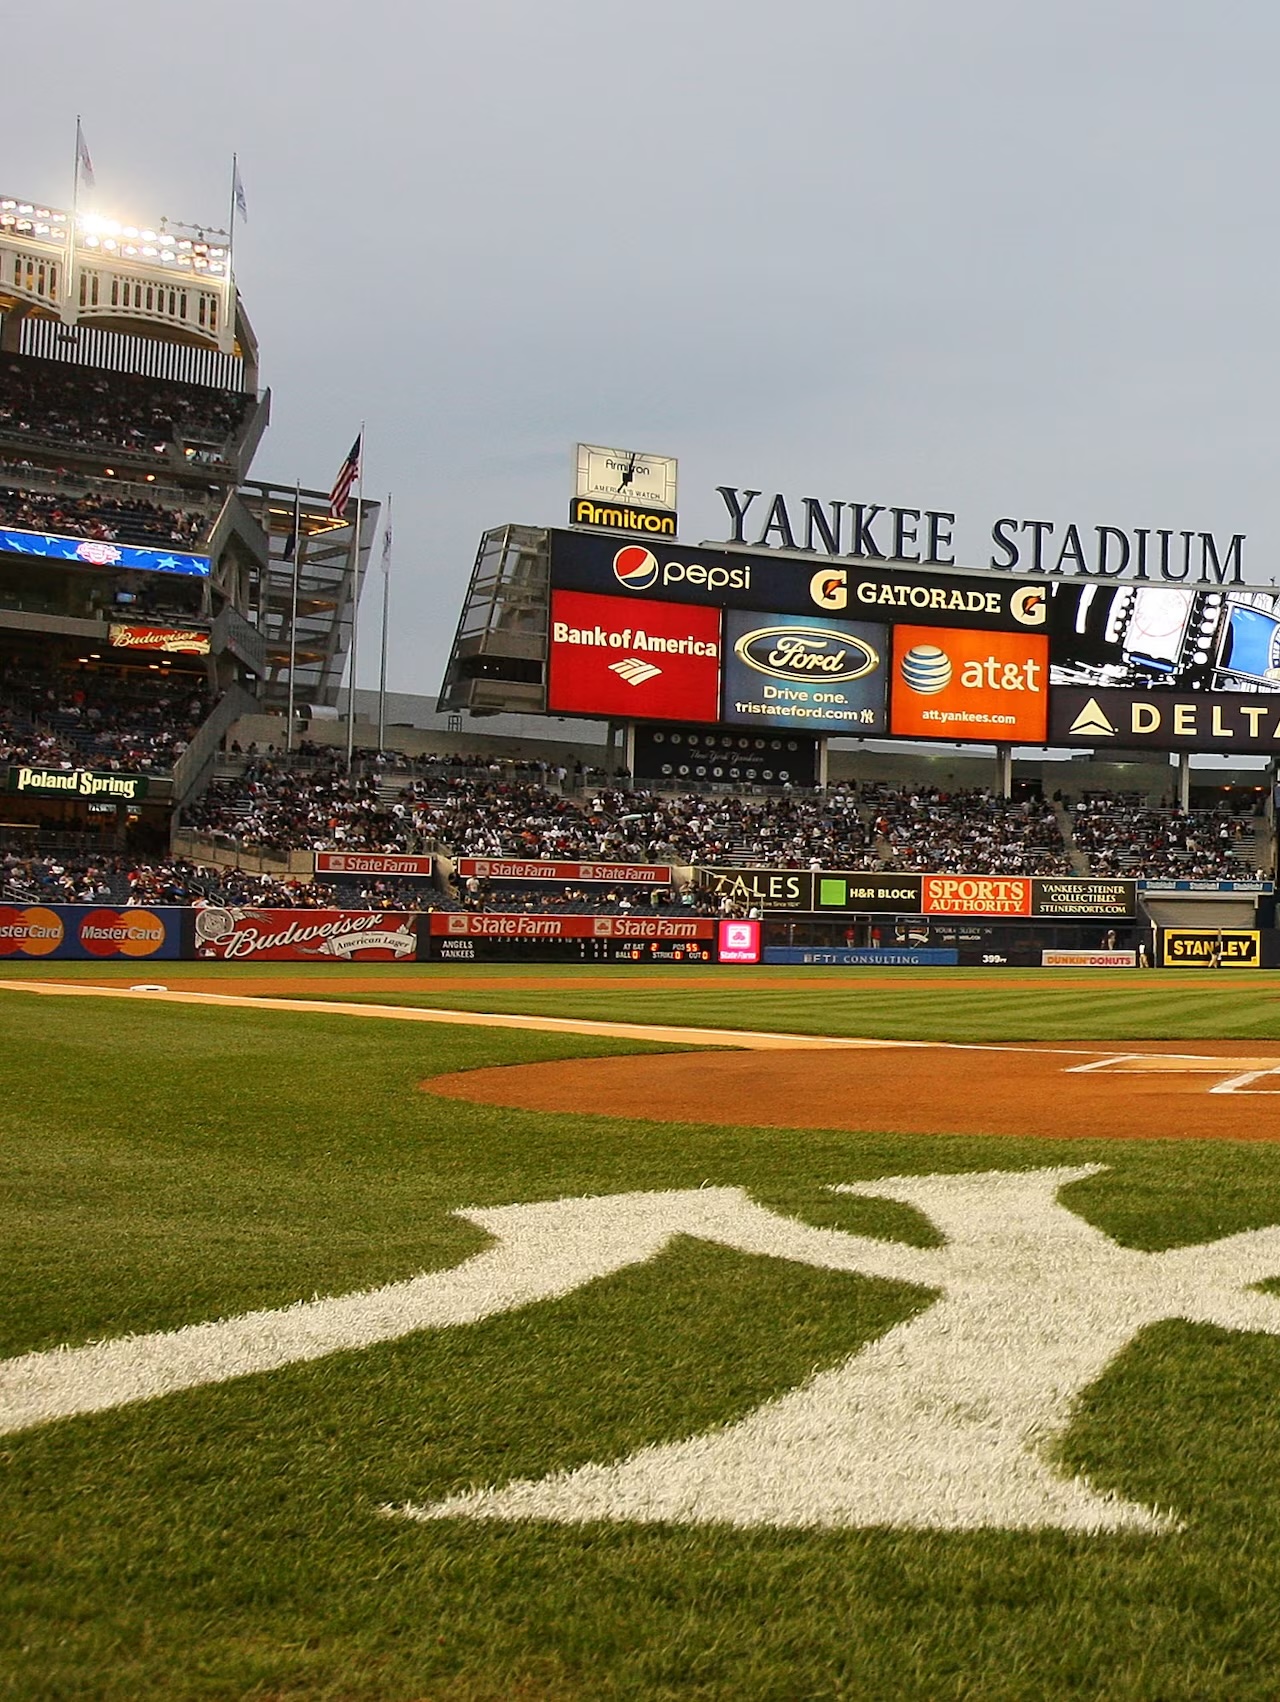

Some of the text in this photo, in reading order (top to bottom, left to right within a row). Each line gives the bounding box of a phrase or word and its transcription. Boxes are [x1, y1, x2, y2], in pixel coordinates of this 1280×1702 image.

[594, 485, 661, 499] AMERIA'S WATCH
[577, 501, 675, 534] Armitron
[716, 486, 1248, 585] YANKEE STADIUM
[663, 561, 750, 591] pepsi
[857, 581, 1001, 613] GATORADE
[113, 631, 197, 647] Budweiser
[553, 622, 718, 658] Bank of America
[768, 636, 846, 672] Ford
[960, 656, 1040, 693] at&t
[763, 685, 849, 704] Drive one.
[734, 702, 858, 721] tristateford.com
[921, 709, 1016, 727] att.yankees.com
[17, 768, 136, 798] Poland Spring
[713, 875, 800, 899] ZALES
[849, 888, 916, 900] H&R BLOCK
[928, 879, 1025, 900] SPORTS
[1041, 884, 1125, 894] YANKEES-STEINER
[928, 899, 1025, 913] AUTHORITY
[1050, 893, 1116, 903] COLLECTIBLES
[1039, 904, 1127, 914] STEINERSPORTS.COM
[0, 925, 63, 940] sterCard
[81, 925, 164, 941] MasterCard
[214, 914, 383, 959] Budweiser
[336, 936, 411, 951] American Lager
[442, 940, 473, 949] ANGELS
[650, 943, 657, 951] 2
[1173, 940, 1251, 956] STANLEY
[441, 949, 474, 958] YANKEES
[615, 951, 631, 959] BALL
[632, 950, 638, 959] 0
[674, 951, 680, 960] 0
[702, 951, 708, 960] 0
[843, 955, 919, 964] CONSULTING
[1089, 956, 1131, 966] DONUTS
